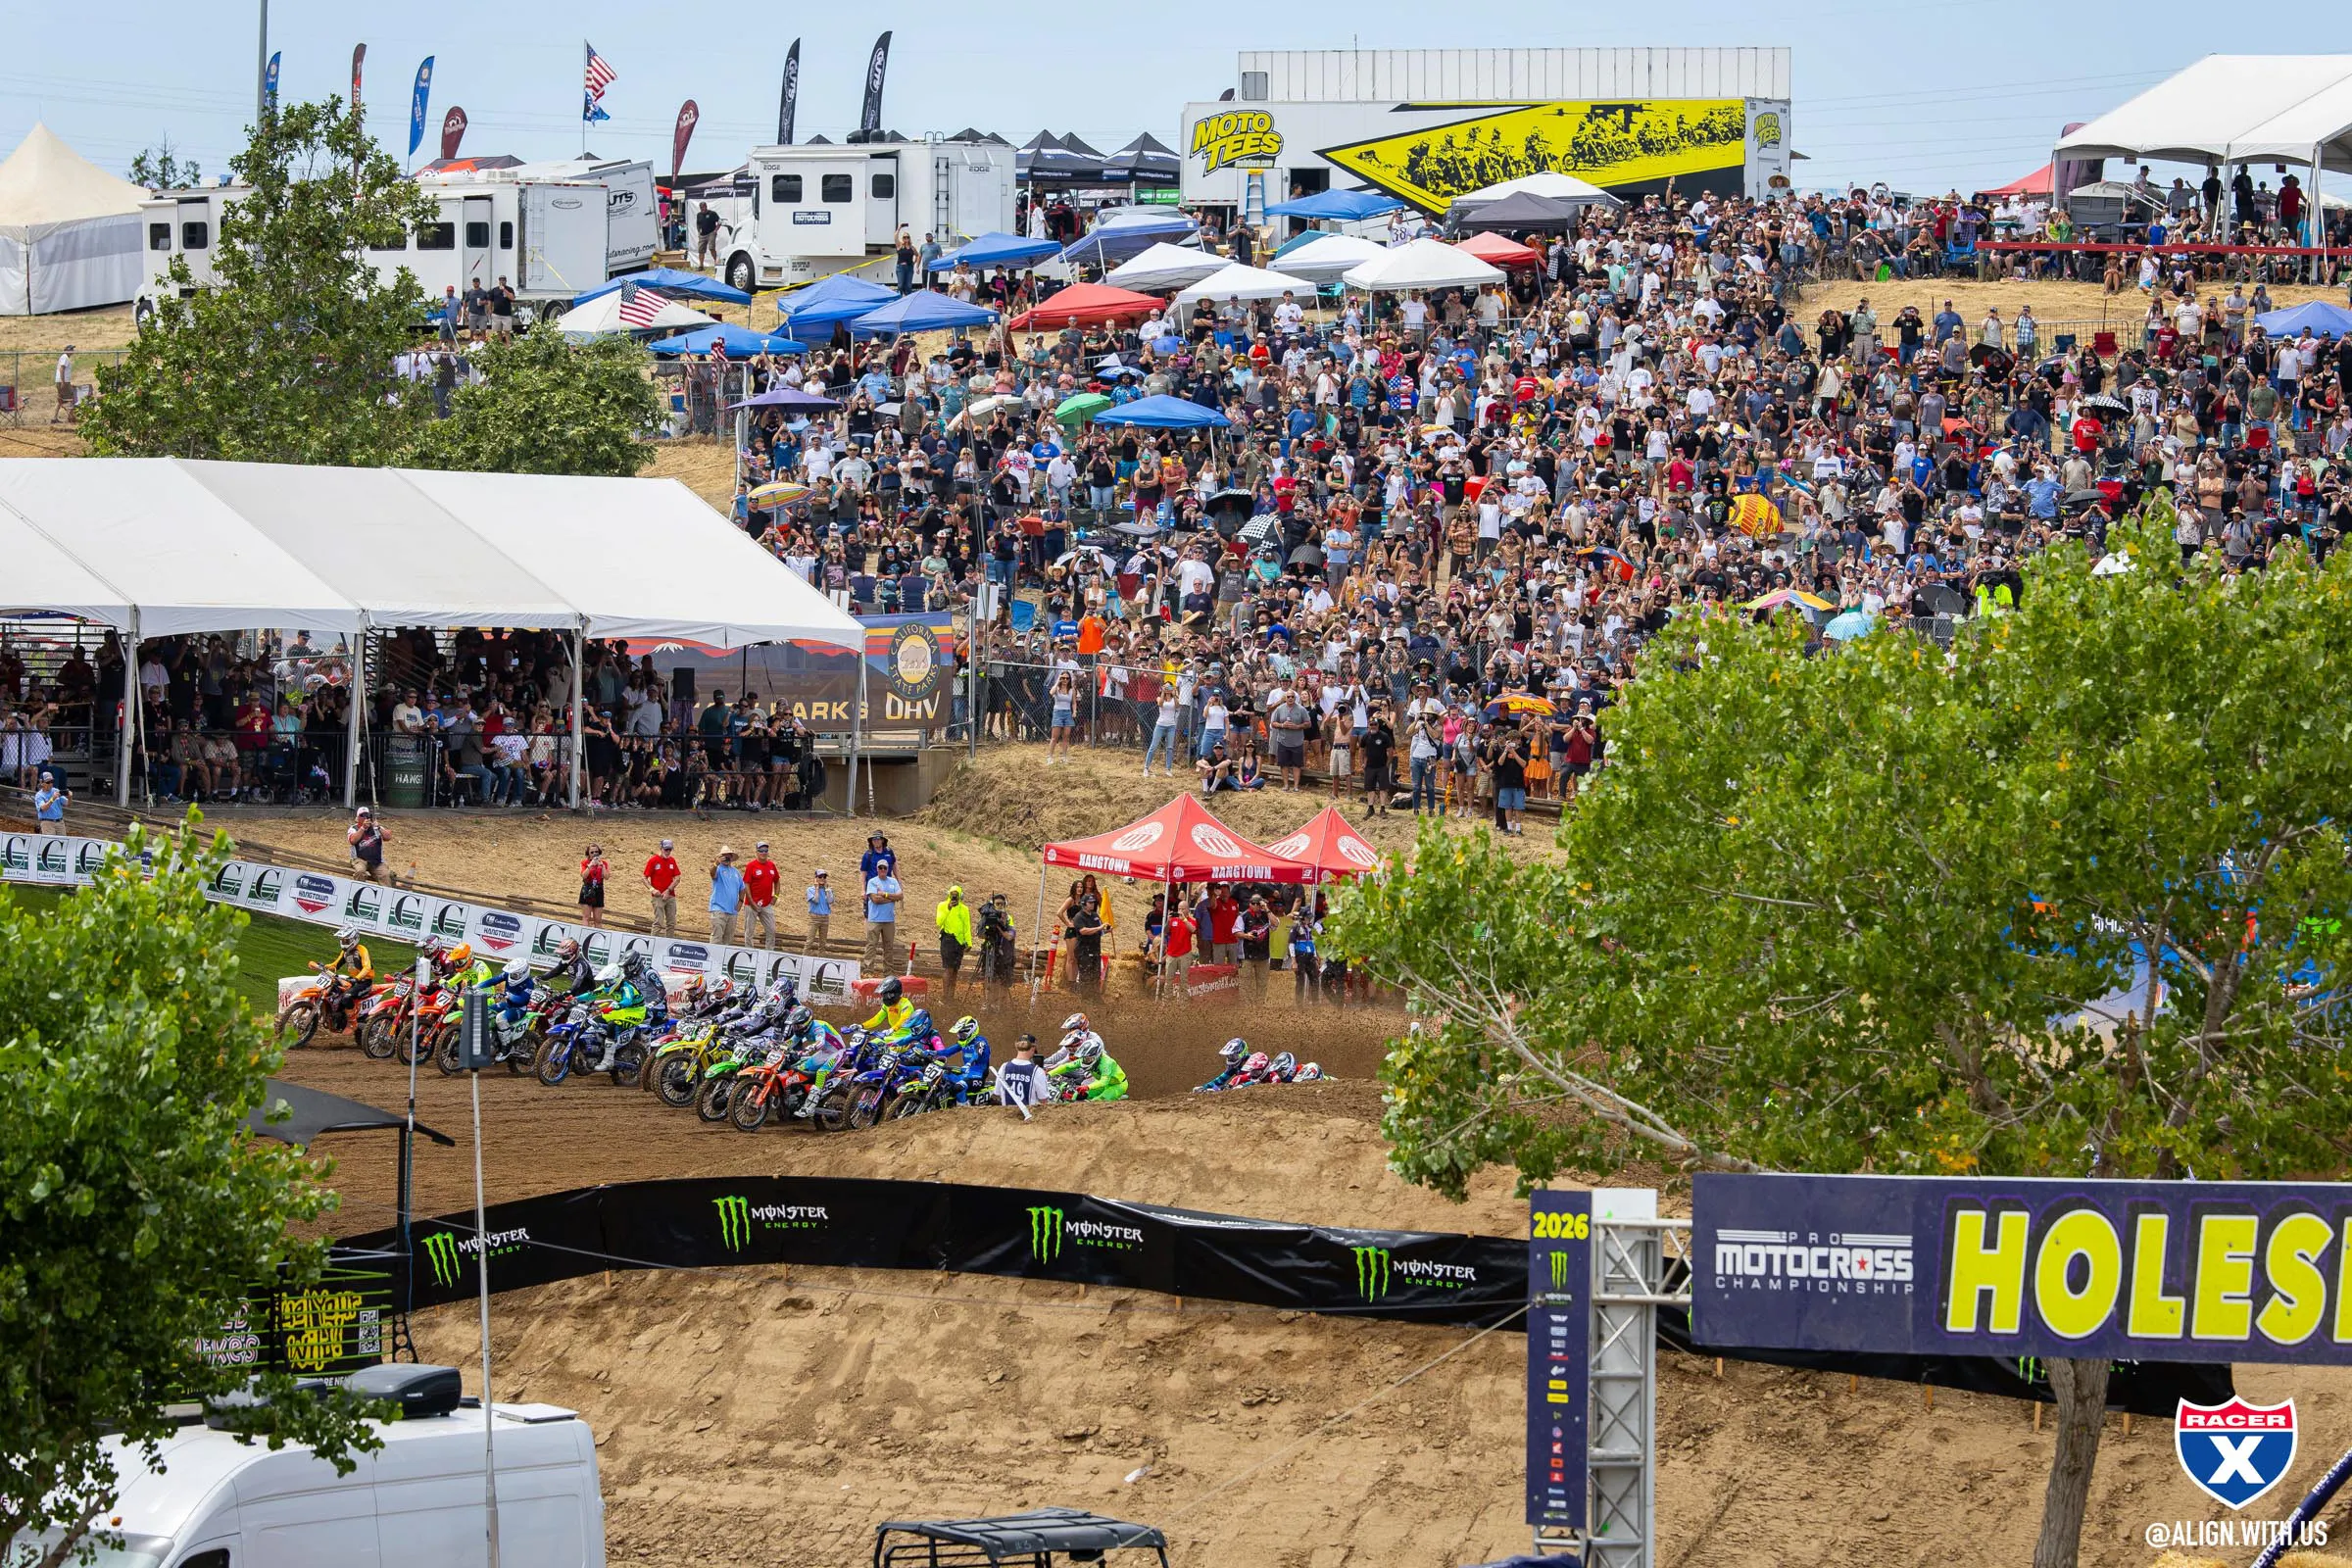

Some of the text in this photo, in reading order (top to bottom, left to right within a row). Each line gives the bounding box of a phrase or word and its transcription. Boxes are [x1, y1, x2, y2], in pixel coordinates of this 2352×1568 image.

[1192, 112, 1272, 155] MOTO
[1754, 114, 1779, 138] MOTO
[1758, 126, 1781, 151] TEES
[1204, 132, 1281, 172] TEES
[608, 192, 634, 206] UTS
[1393, 226, 1407, 243] 38
[608, 243, 657, 259] utsracing.com
[890, 623, 938, 655] CALIFORNIA
[1079, 854, 1131, 873] HANGTOWN
[1211, 864, 1272, 879] HANGTOWN
[299, 890, 329, 902] HANGTOWN
[360, 919, 374, 928] Pump
[403, 928, 417, 937] Pump
[483, 927, 514, 939] HANGTOWN
[671, 957, 703, 968] HANGTOWN
[316, 977, 330, 988] 671
[362, 1000, 373, 1010] 671
[1005, 1073, 1031, 1083] PRESS
[751, 1204, 828, 1221] MONSTER
[1065, 1220, 1144, 1243] MONSTER
[1533, 1211, 1590, 1240] 2026
[1076, 1238, 1133, 1250] ENERGY
[1788, 1232, 1840, 1246] PRO
[471, 1245, 521, 1261] EERGY
[1393, 1259, 1477, 1281] MONSTER
[1715, 1244, 1914, 1281] MOTOCROSS
[1404, 1277, 1464, 1289] ENERGY
[1946, 1209, 2352, 1345] HOLES
[1715, 1276, 1914, 1295] CHAMPIONSHIP
